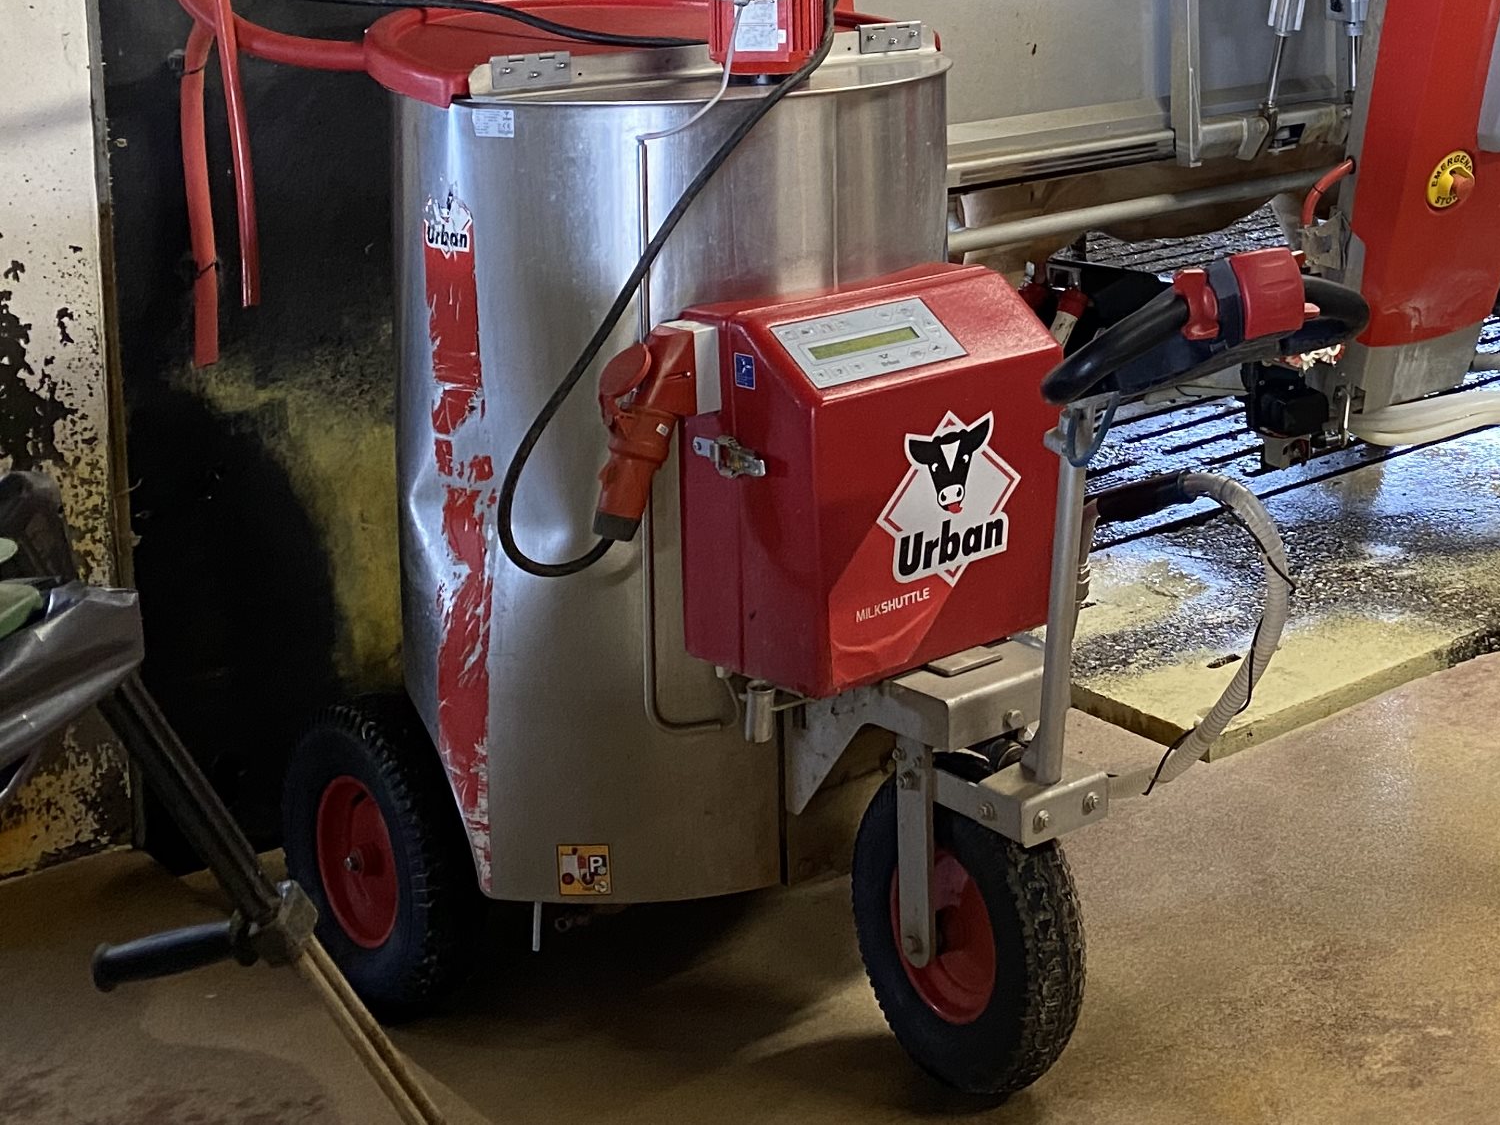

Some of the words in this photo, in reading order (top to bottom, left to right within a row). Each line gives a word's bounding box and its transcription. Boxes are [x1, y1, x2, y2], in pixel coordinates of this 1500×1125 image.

[1431, 155, 1472, 187] EMERGENC
[427, 224, 468, 248] Urban
[898, 518, 1004, 576] Urban
[855, 587, 930, 623] MILKSHUTTLE
[590, 856, 603, 873] P
